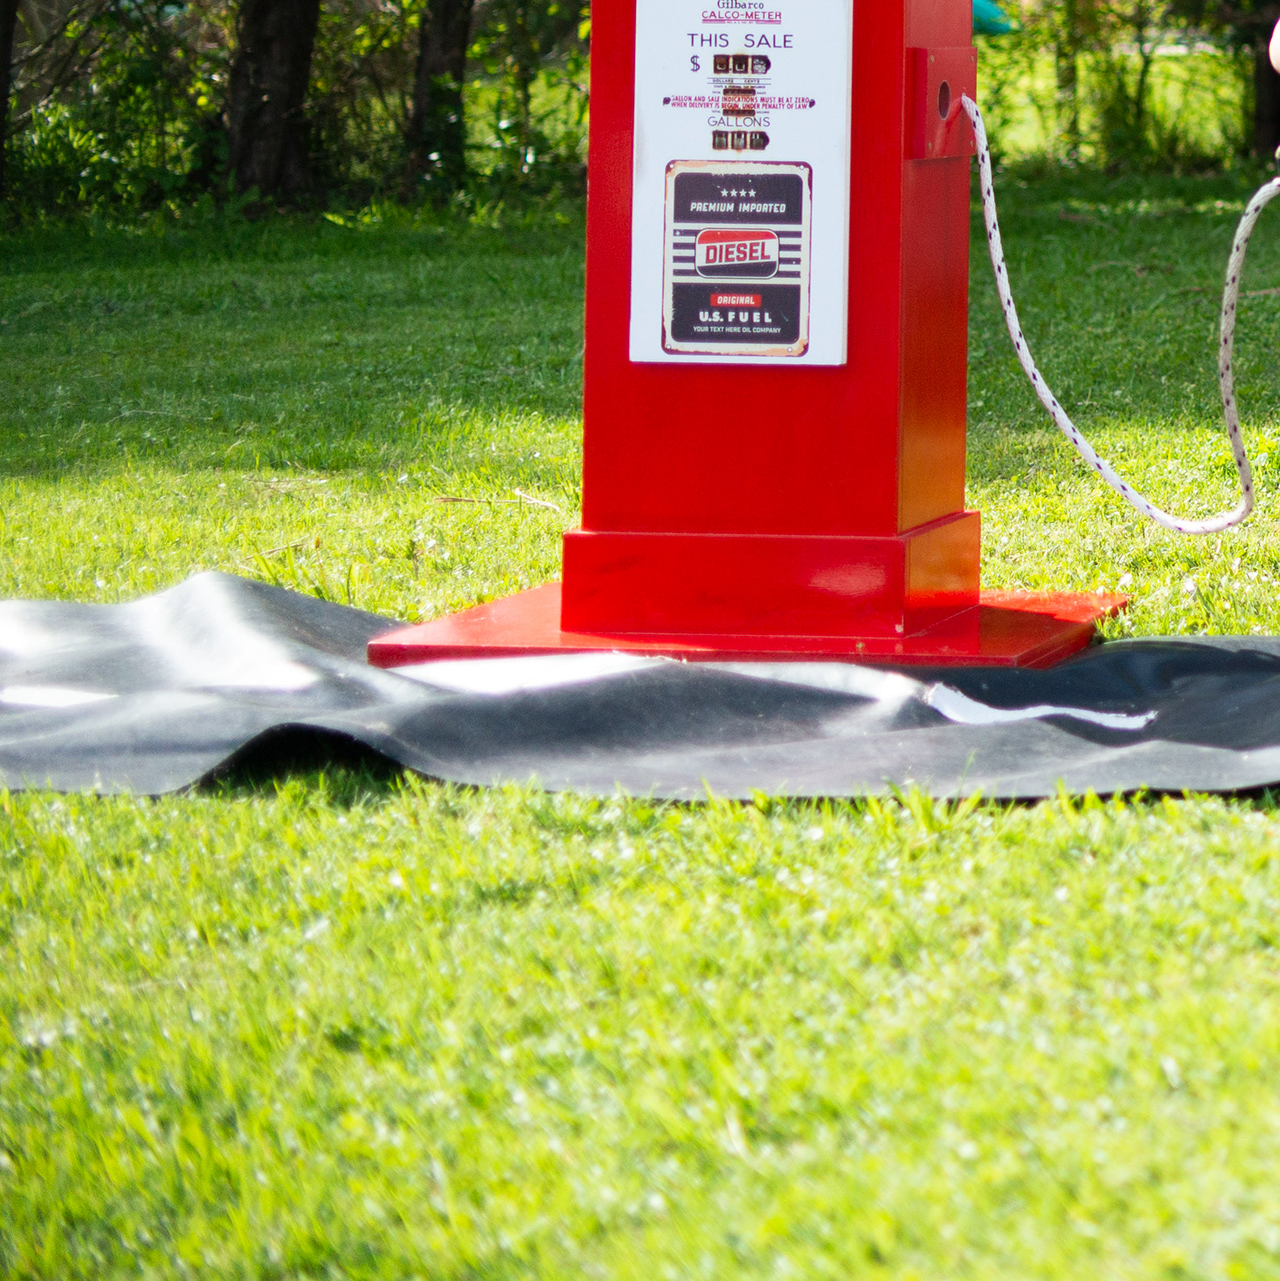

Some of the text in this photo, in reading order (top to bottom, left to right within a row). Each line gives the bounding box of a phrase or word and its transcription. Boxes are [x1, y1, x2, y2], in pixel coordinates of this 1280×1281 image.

[701, 10, 782, 20] CALCO-METER
[687, 33, 794, 49] THIS SALE
[690, 55, 700, 72] $
[707, 116, 771, 127] GALLONS
[690, 202, 787, 213] PREMIUM IMPORTED
[705, 241, 771, 264] DIESEL
[717, 296, 755, 305] ORIGINAL
[699, 311, 772, 323] U.S. FUEL
[693, 325, 709, 333] YOUR
[710, 325, 725, 333] TEXT
[742, 326, 752, 334] OIL
[752, 326, 781, 334] COMPANY
